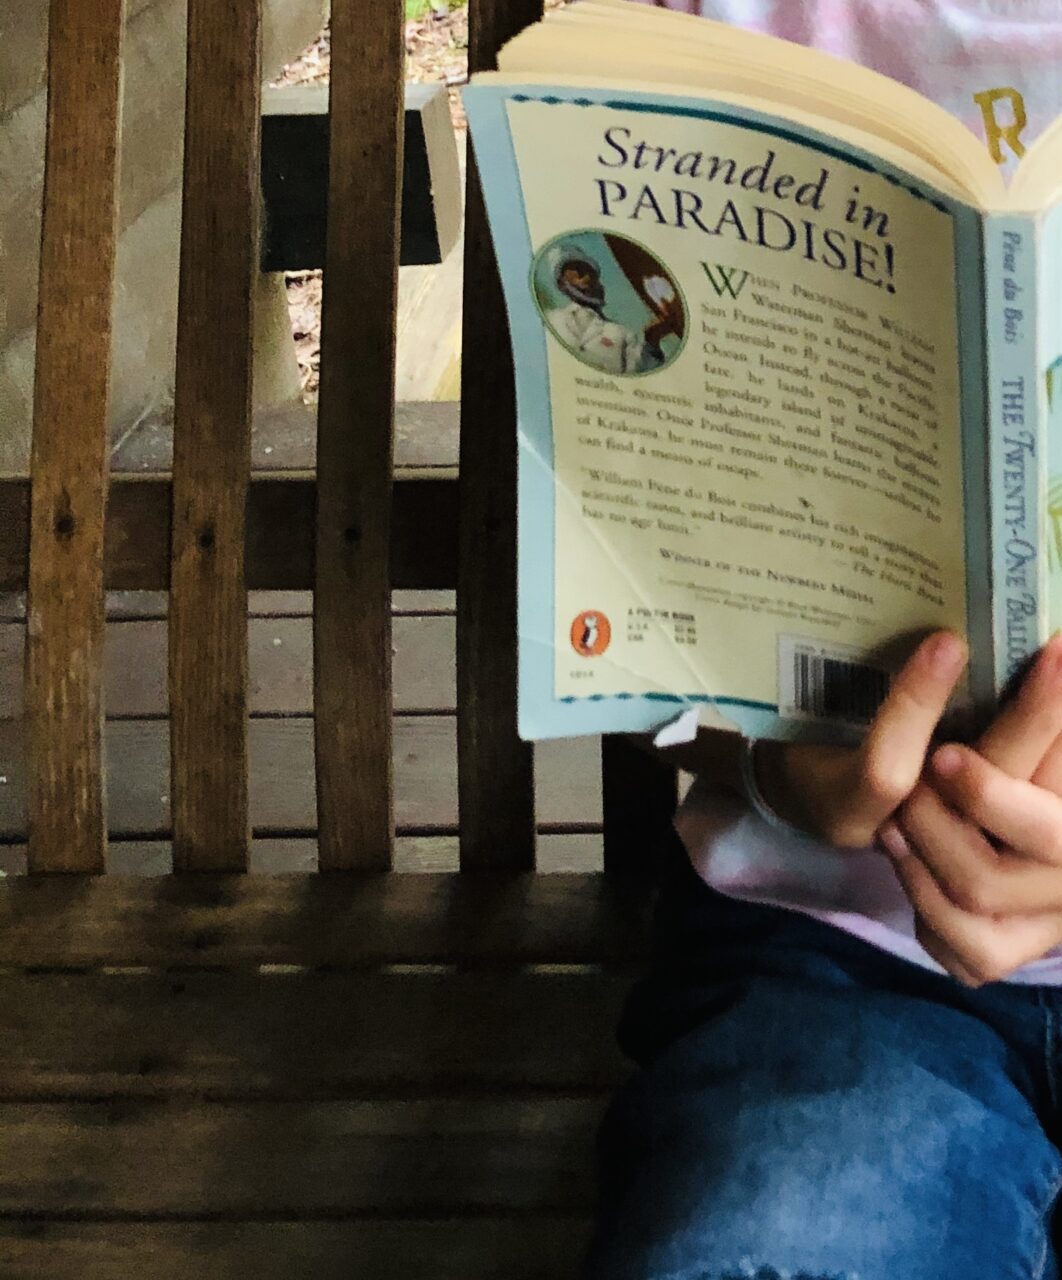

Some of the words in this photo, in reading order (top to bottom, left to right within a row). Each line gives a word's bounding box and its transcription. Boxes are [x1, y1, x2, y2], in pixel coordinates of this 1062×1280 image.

[597, 125, 829, 212] Stranded
[845, 185, 890, 238] in
[594, 178, 896, 294] PARADISE!
[751, 292, 824, 324] Waterman
[1003, 277, 1024, 302] du
[701, 301, 727, 319] San
[733, 308, 799, 337] Francisco
[1003, 306, 1025, 345] Bois
[702, 319, 719, 336] he
[725, 329, 776, 350] intends
[782, 343, 798, 356] to
[803, 345, 820, 364] fly
[871, 371, 893, 390] the
[705, 381, 771, 409] legendary
[781, 400, 822, 420] island
[831, 414, 845, 428] of
[749, 370, 765, 386] he
[777, 378, 815, 399] lands
[827, 395, 846, 409] on
[1001, 376, 1025, 426] THE
[656, 408, 694, 428] Once
[700, 416, 761, 441] Professor
[768, 432, 828, 458] Sherman
[877, 468, 898, 483] the
[668, 429, 685, 443] he
[691, 438, 724, 452] must
[731, 445, 778, 464] remain
[796, 424, 821, 438] and
[577, 435, 602, 447] can
[605, 436, 634, 454] find
[639, 446, 647, 455] a
[651, 448, 694, 465] means
[698, 456, 714, 467] of
[582, 503, 605, 520] has
[609, 512, 627, 523] no
[708, 489, 737, 508] Bois
[1003, 429, 1037, 588] TWENTY-ONE
[691, 509, 716, 522] and
[831, 539, 845, 551] to
